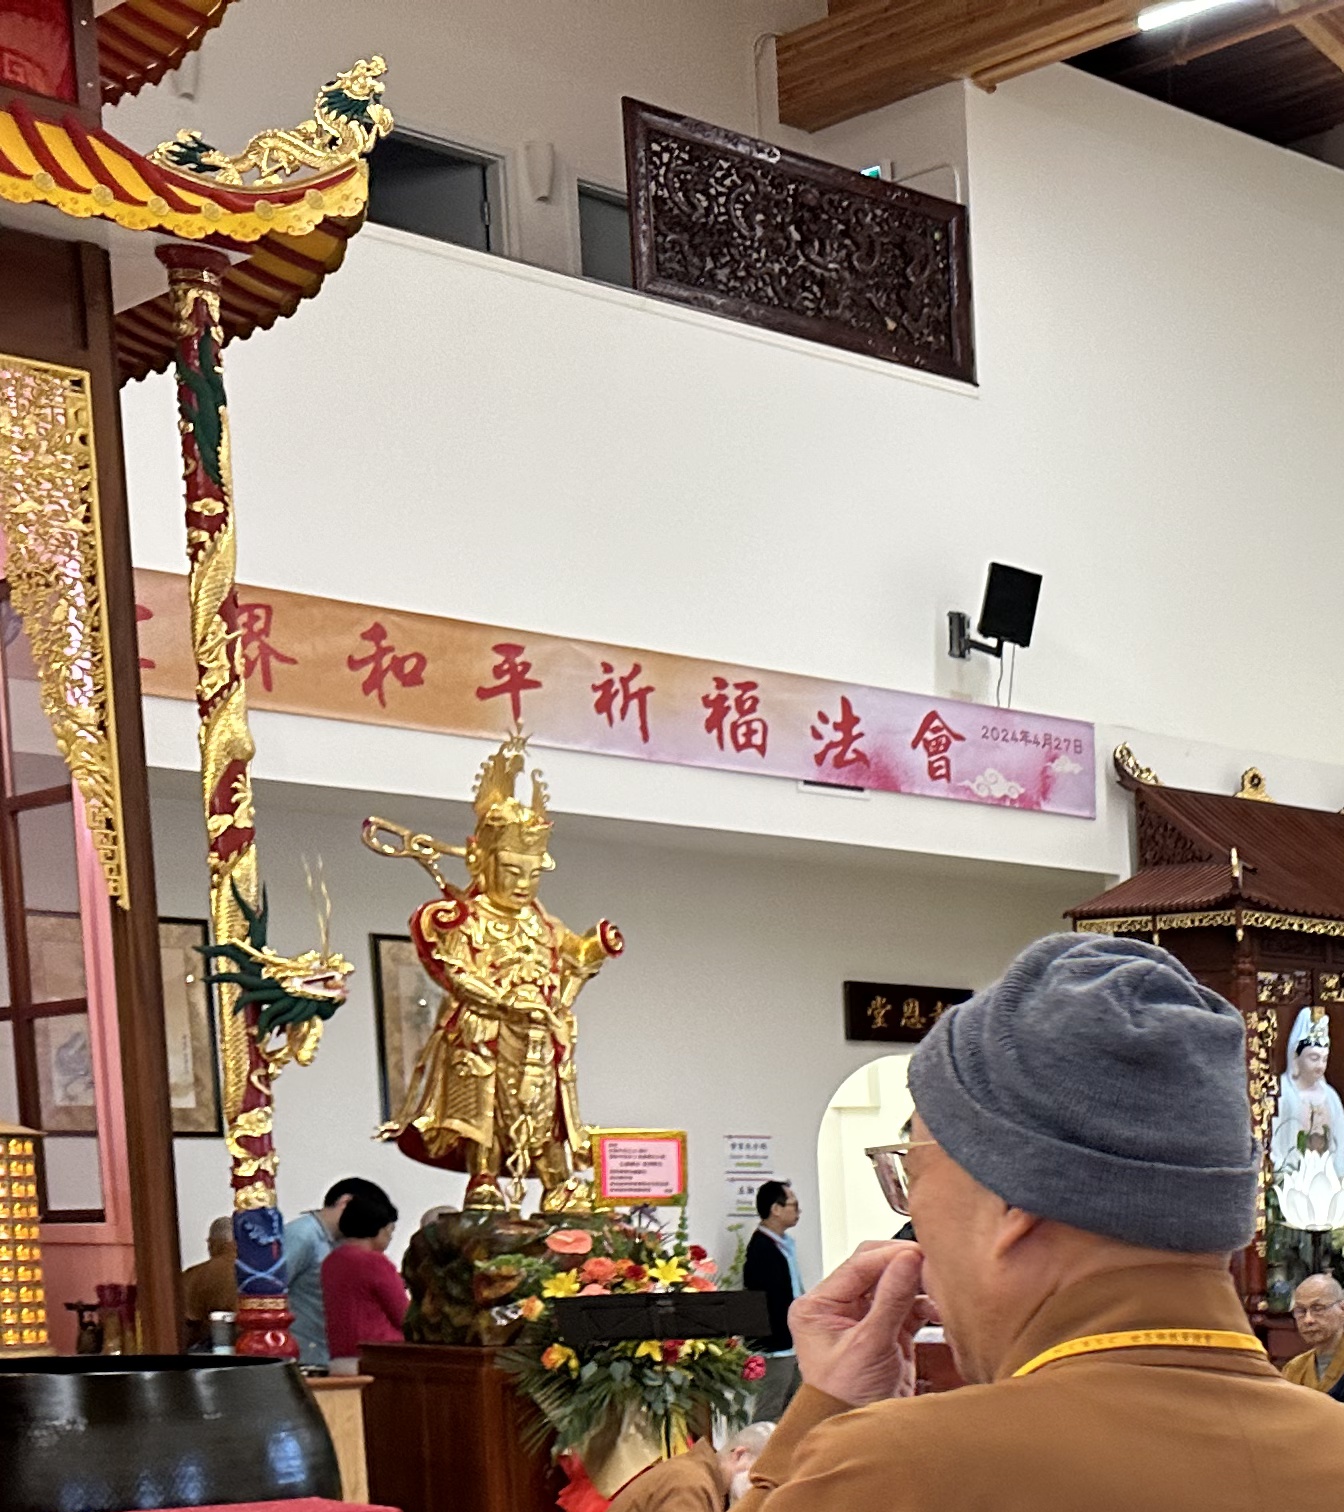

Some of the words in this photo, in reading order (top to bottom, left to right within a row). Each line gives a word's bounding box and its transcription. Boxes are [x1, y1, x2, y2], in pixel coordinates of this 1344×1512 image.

[136, 603, 966, 783] 界和平祈福法會
[981, 725, 1083, 755] 2024年4月27日
